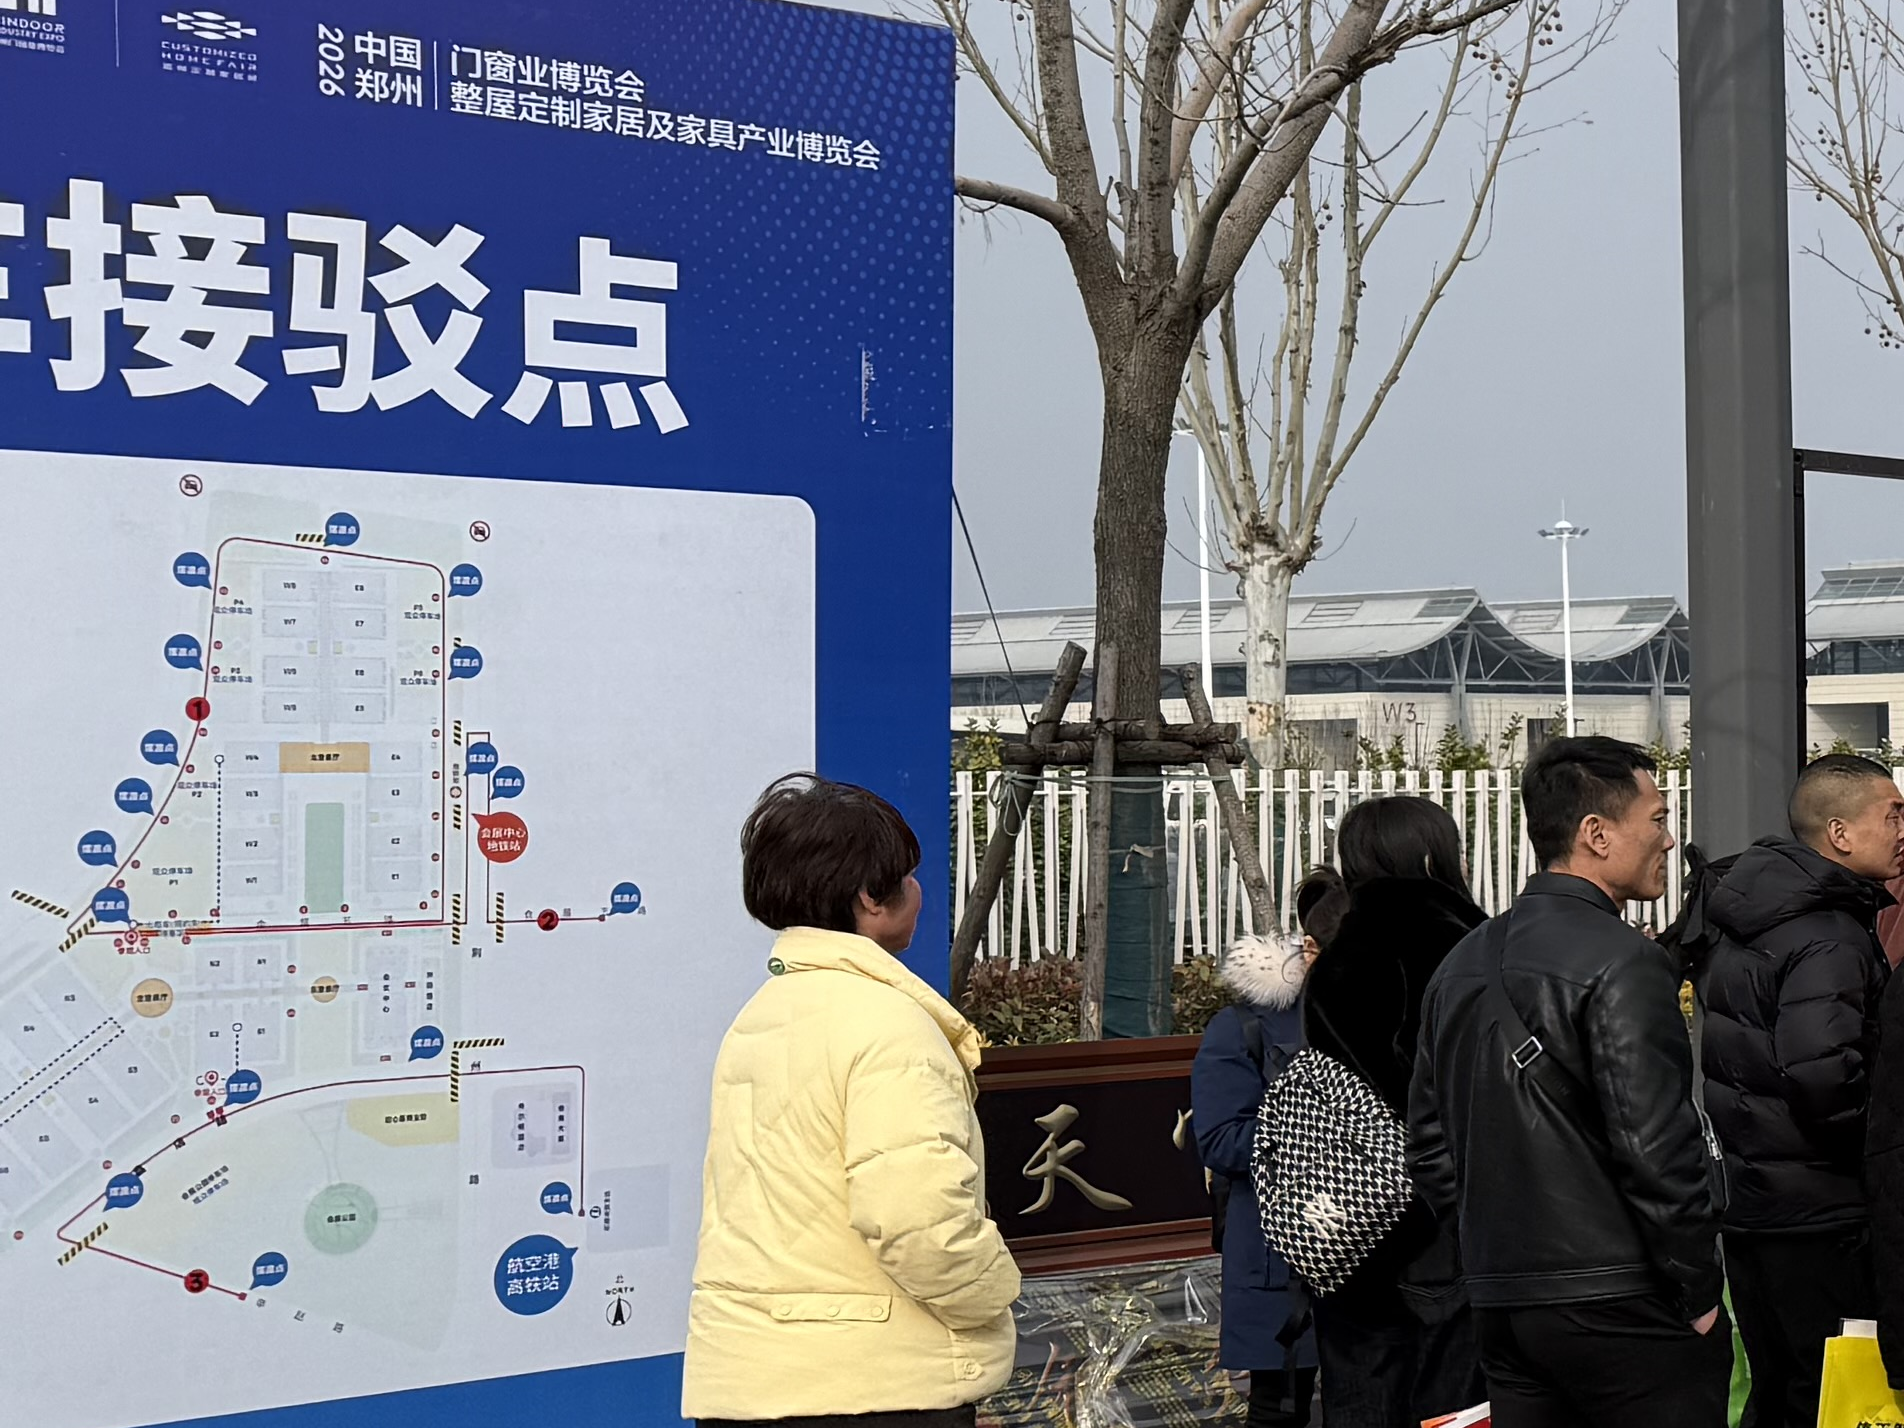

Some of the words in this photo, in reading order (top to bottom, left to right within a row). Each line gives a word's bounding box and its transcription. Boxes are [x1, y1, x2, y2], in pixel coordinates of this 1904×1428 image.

[0, 15, 66, 34] INDOOR
[161, 52, 211, 66] HOME
[216, 58, 258, 72] FAIR
[315, 22, 346, 99] 2026
[353, 31, 423, 72] 中国
[450, 44, 646, 103] 门窗业博览会
[353, 67, 423, 109] 郑州
[449, 80, 881, 171] 整屋定制家居及家具产业博览会
[0, 177, 690, 434] 接驳点
[1382, 702, 1417, 723] W3
[506, 1252, 561, 1274] 航空港
[506, 1274, 561, 1297] 高铁站
